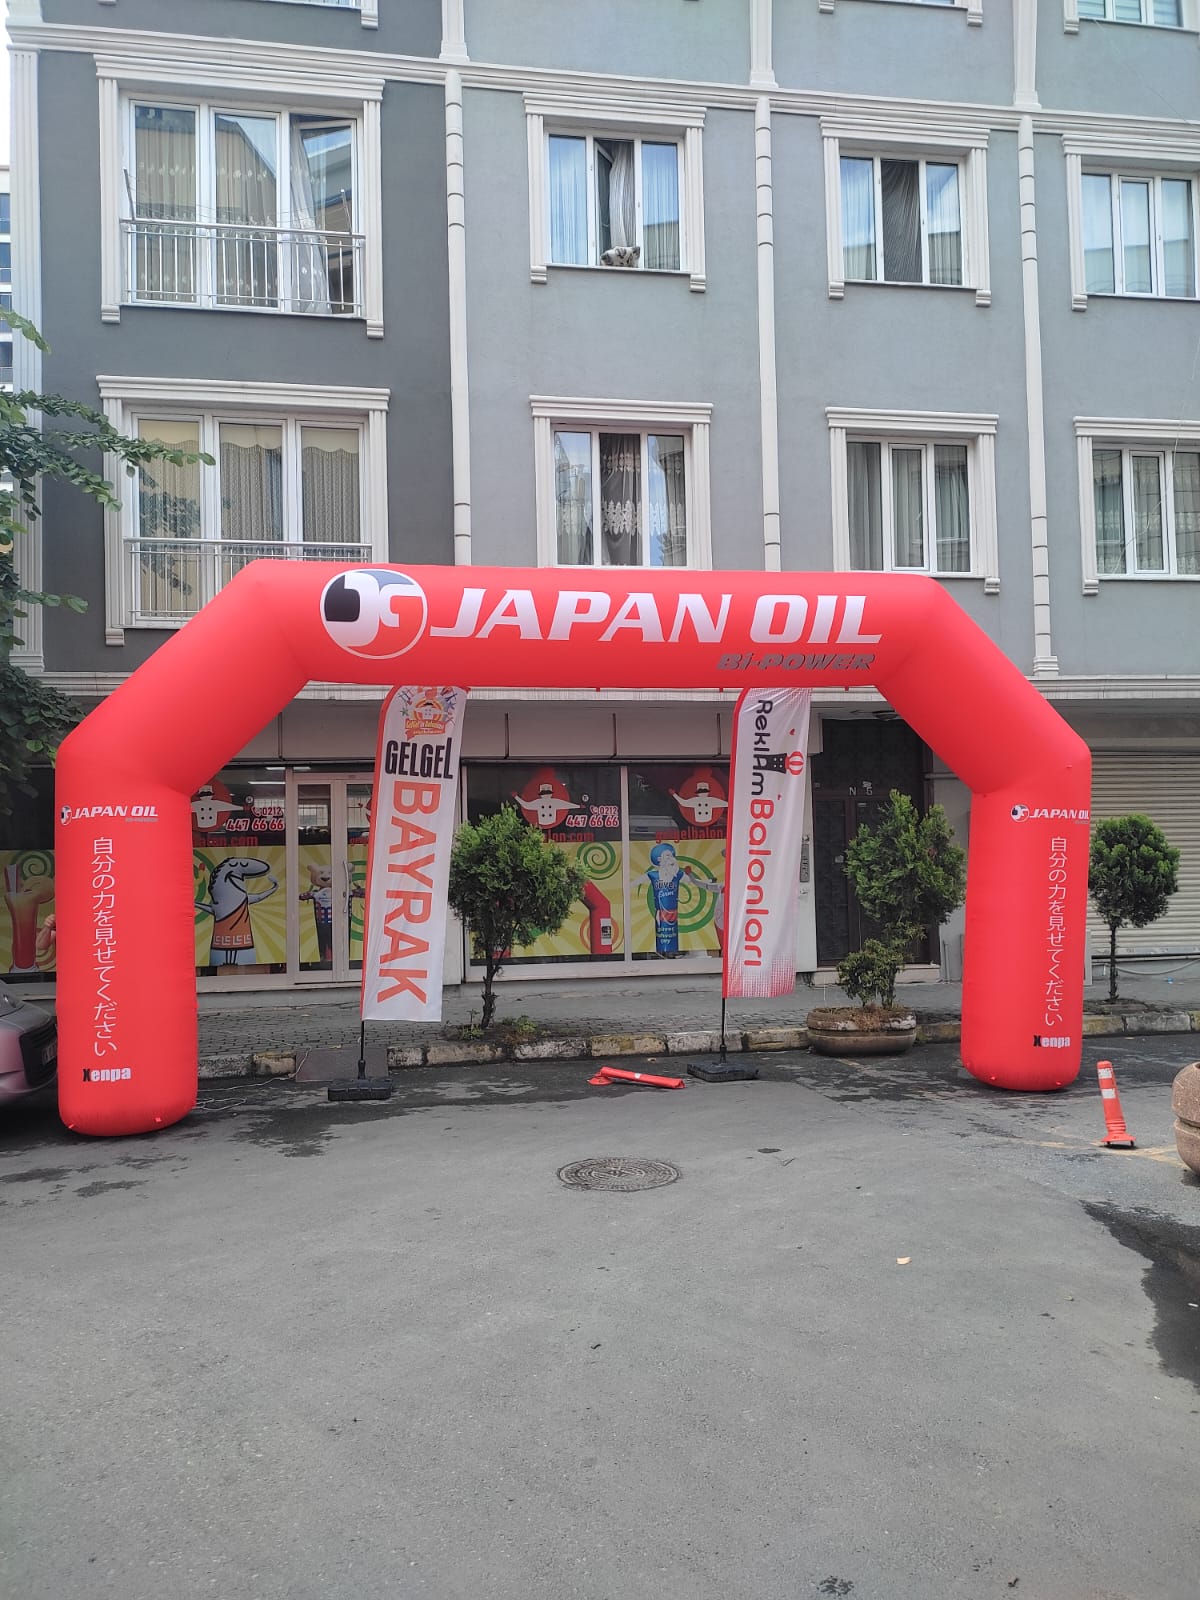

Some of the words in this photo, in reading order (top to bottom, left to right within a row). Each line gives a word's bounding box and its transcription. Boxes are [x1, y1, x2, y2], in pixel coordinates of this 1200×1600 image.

[429, 587, 733, 643] JAPAN
[749, 594, 883, 644] OIL
[384, 737, 454, 779] GELGEL
[72, 805, 128, 820] JAPAN
[131, 806, 158, 817] OIL
[262, 805, 283, 817] 0212
[599, 805, 619, 815] 0212
[1029, 808, 1077, 819] JAPAN
[1078, 809, 1089, 820] OIL
[226, 818, 250, 831] 447
[251, 818, 268, 831] 66
[269, 818, 285, 831] 66
[566, 815, 588, 827] 447
[589, 815, 604, 827] 66
[605, 815, 620, 827] 66
[377, 780, 442, 1004] BAYRAK
[1045, 836, 1067, 1026] 自分の力を見せてください
[91, 836, 117, 1057] 自分の力を見せてください
[1033, 1035, 1070, 1048] Xenpa
[82, 1067, 132, 1082] Xenpa
